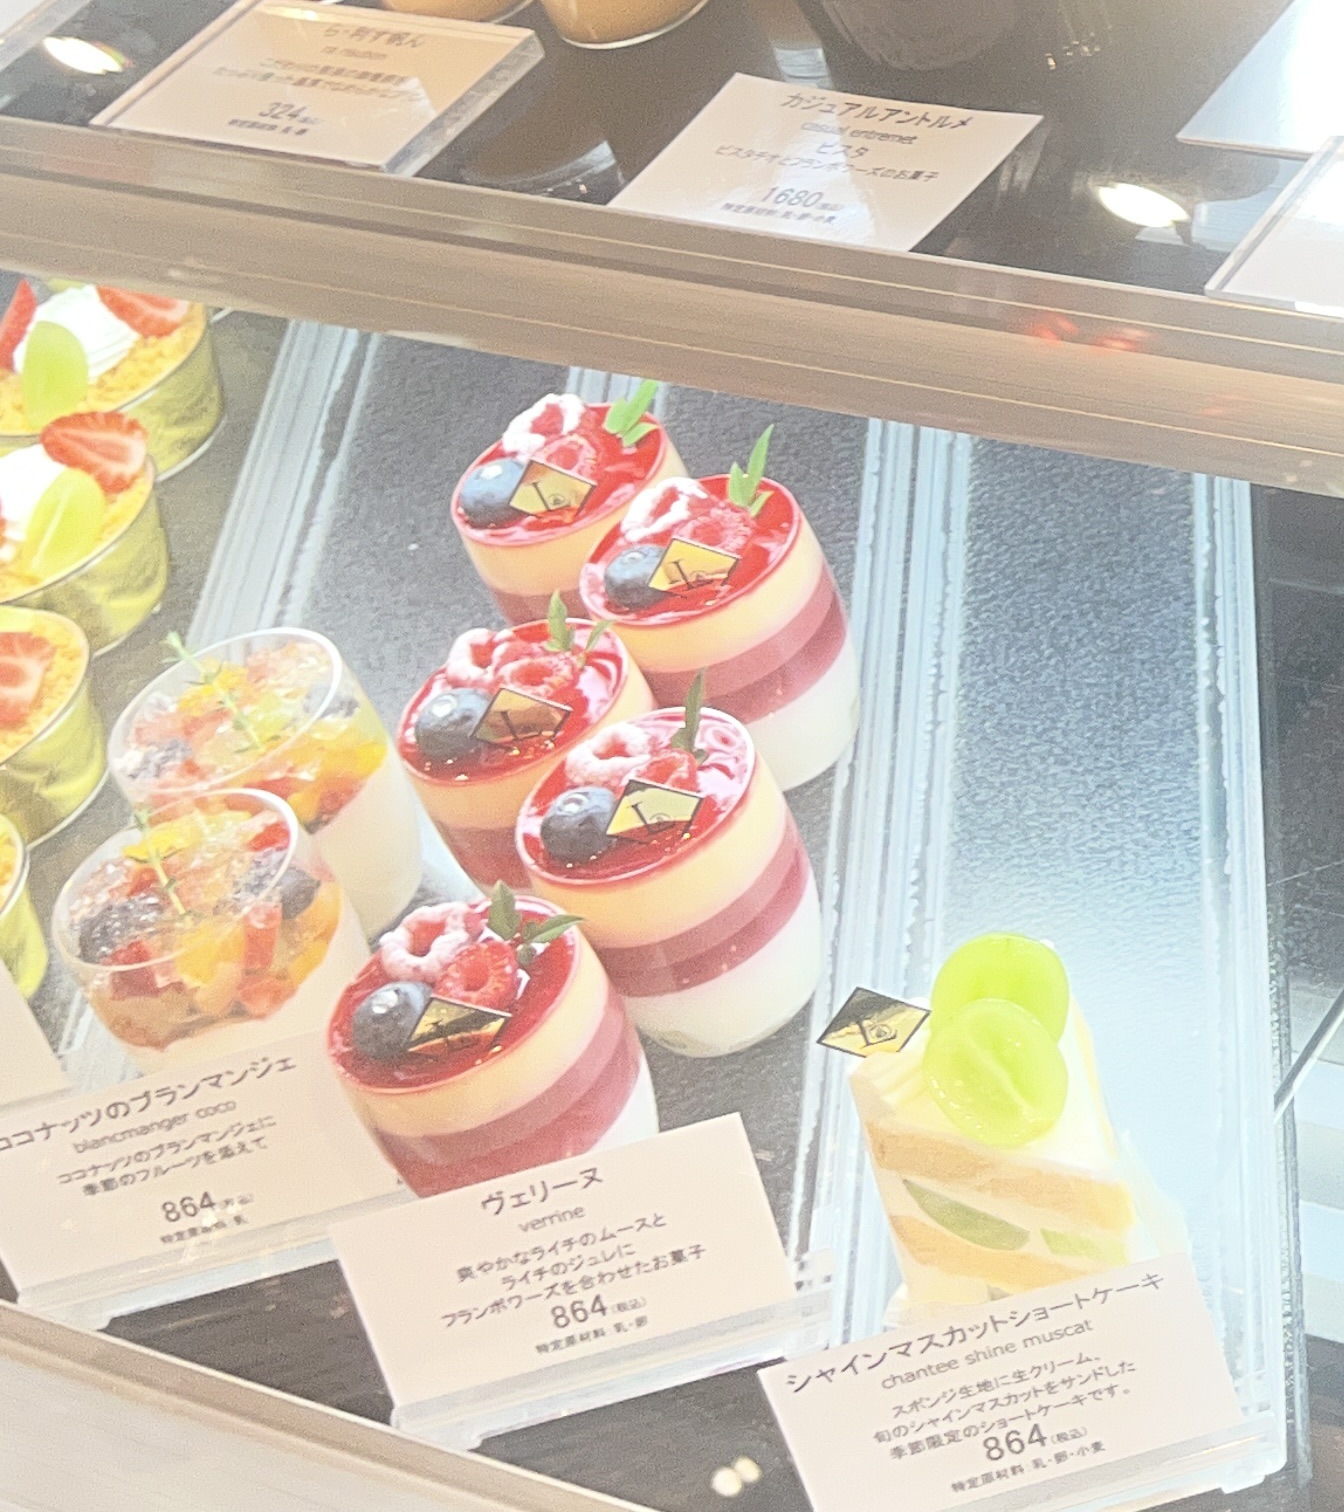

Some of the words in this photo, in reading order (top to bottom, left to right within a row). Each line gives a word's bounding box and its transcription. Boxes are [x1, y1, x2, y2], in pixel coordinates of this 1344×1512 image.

[258, 101, 307, 119] 324
[781, 92, 974, 130] カジュアルアントルメ
[816, 143, 869, 158] ピスタ
[761, 186, 824, 208] 1680
[161, 1190, 216, 1222] 864
[480, 1167, 604, 1216] ヴェリーヌ
[517, 1206, 586, 1233] verrine
[456, 1212, 668, 1283] 爽やかなライチのムースと
[500, 1243, 636, 1292] ライチのジュレに
[441, 1243, 707, 1328] フランボワーズを合わせたお菓子
[551, 1294, 608, 1328] 864
[785, 1272, 1165, 1394] シャインマスカットショートケーキ
[881, 1355, 959, 1390] chantee
[965, 1338, 1017, 1366] shine
[1023, 1318, 1093, 1347] muscat
[873, 1360, 1136, 1444] 旬のシャインマスカットをサンドした
[892, 1351, 1102, 1419] スポンジ生地に生クリーム、
[890, 1383, 1132, 1461] 季節限定のショートケーキです。
[983, 1423, 1048, 1461] 864
